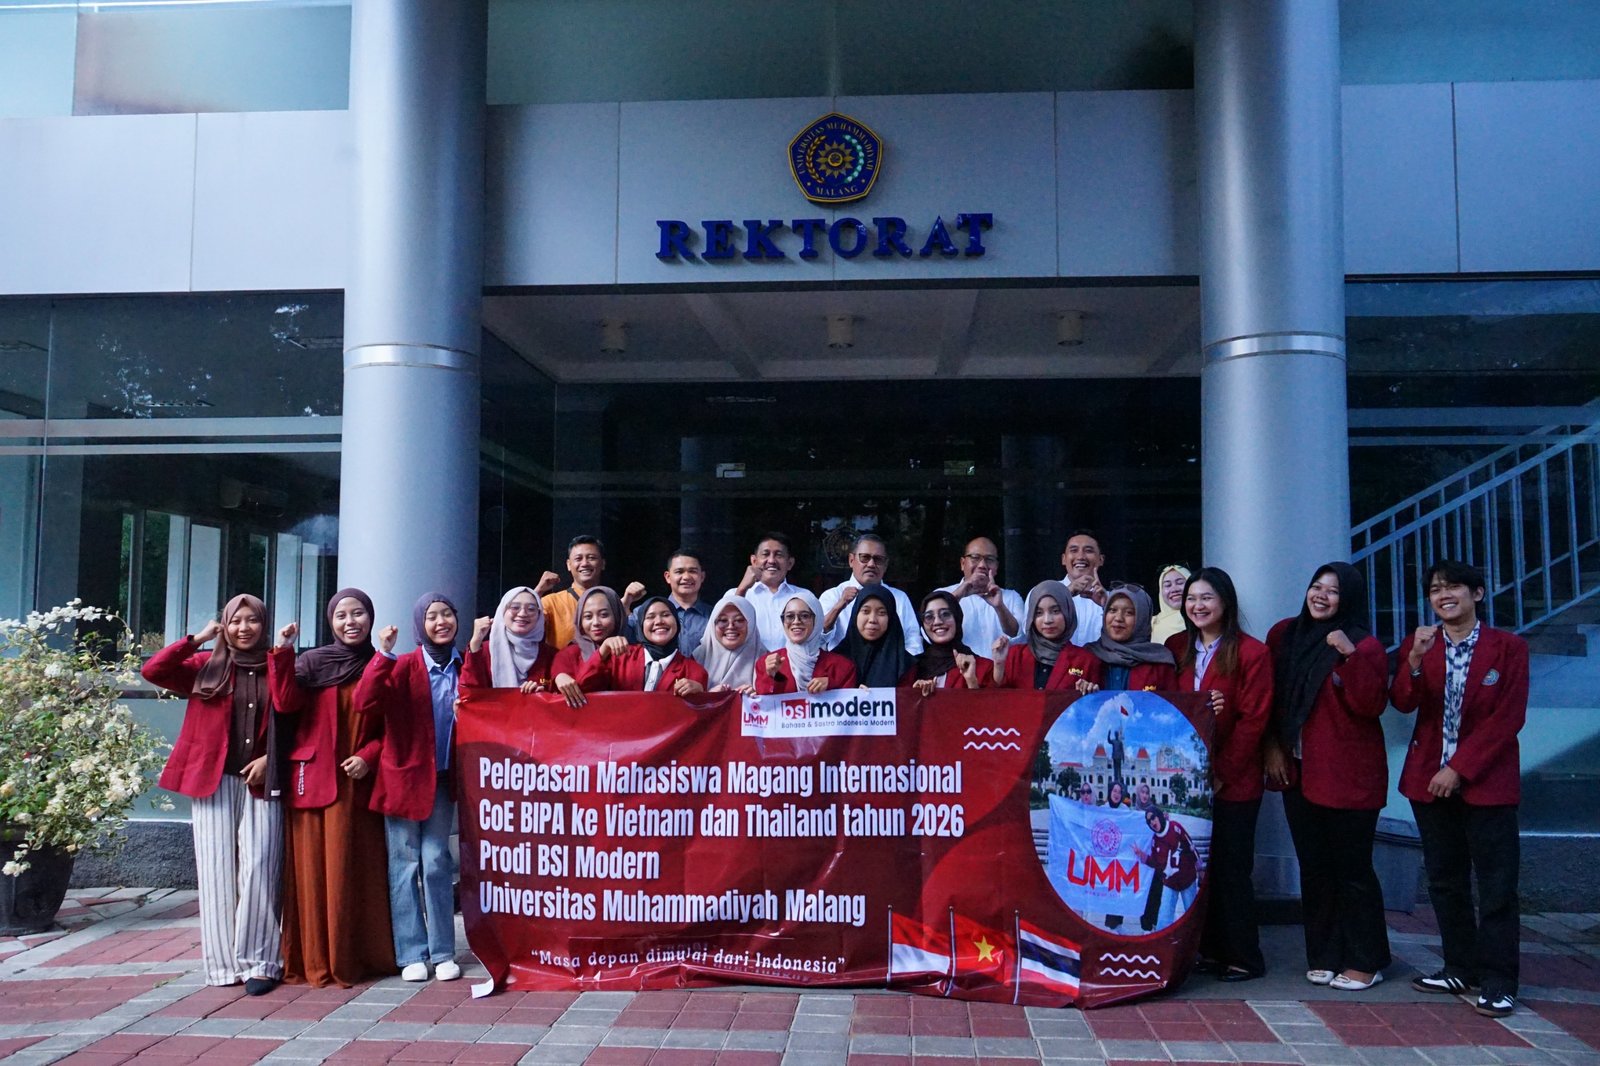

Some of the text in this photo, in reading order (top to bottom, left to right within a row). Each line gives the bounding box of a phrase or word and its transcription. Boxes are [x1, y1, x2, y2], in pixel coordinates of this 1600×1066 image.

[797, 122, 875, 175] UNIVERSITAS MUHAMMADIYAH
[816, 185, 859, 196] MALANG
[655, 213, 993, 259] REKTORAT
[744, 712, 769, 726] UMM
[814, 720, 836, 728] Sastra
[837, 719, 869, 727] Indonesia
[870, 719, 895, 727] Modern
[479, 757, 962, 797] Pelepasan Mahasiswa Magang Internasional
[479, 798, 965, 838] CoE BIPA ke Vietnam dan Thailand tahun 2026
[479, 839, 660, 880] Prodi BSI Modern
[1067, 848, 1140, 894] UMM
[479, 881, 866, 927] Universitas Muhammadiyah Malang
[588, 952, 639, 969] depan
[713, 948, 750, 966] dari
